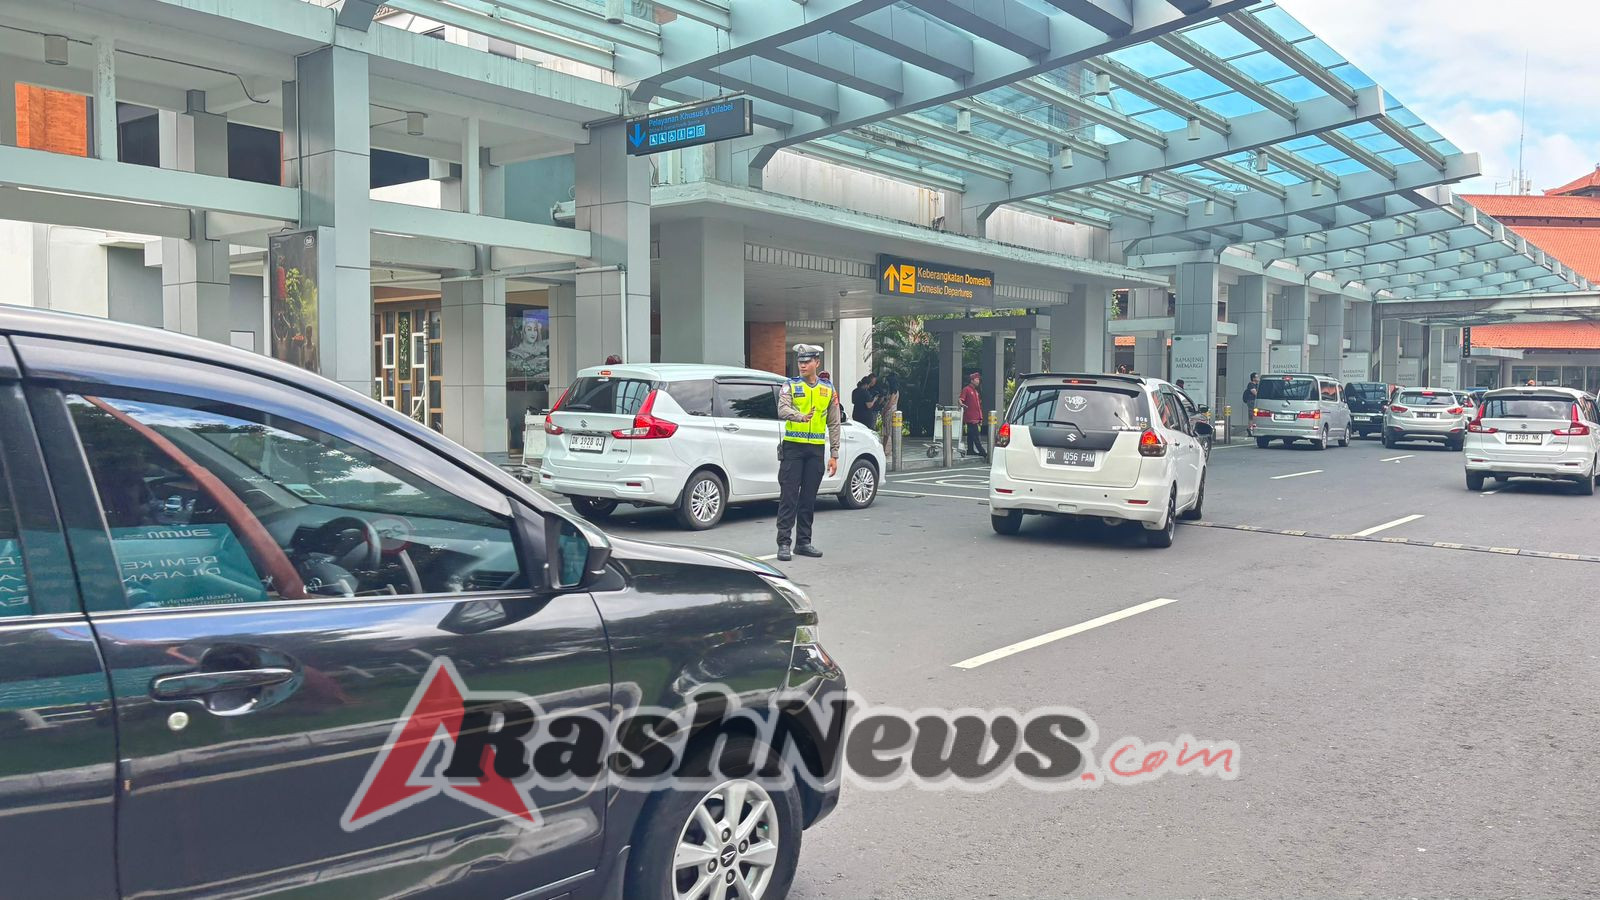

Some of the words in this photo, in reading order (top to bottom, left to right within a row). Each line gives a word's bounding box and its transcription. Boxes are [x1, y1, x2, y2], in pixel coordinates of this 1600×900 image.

[649, 115, 679, 127] Pelayanan
[679, 111, 704, 120] Khusus
[711, 103, 734, 113] Difabel
[917, 267, 964, 283] Keberangkatan
[964, 274, 992, 287] Domestik
[917, 282, 943, 295] Domestic
[944, 285, 973, 298] Departures
[1047, 450, 1056, 459] DK
[1063, 452, 1079, 461] 1056
[1081, 453, 1095, 462] FAM
